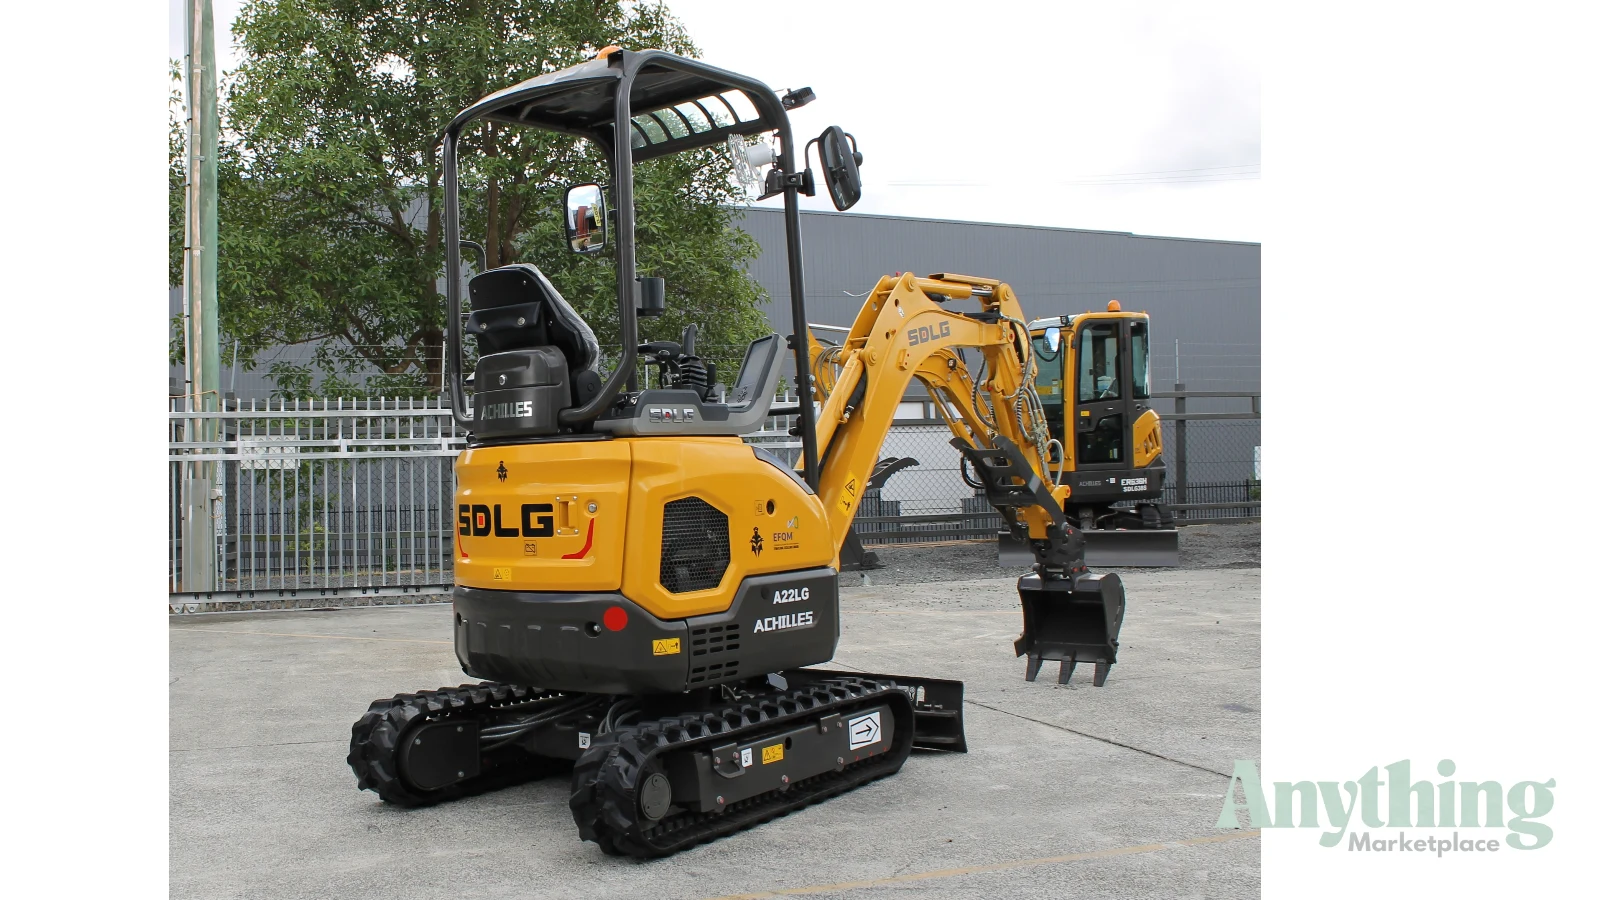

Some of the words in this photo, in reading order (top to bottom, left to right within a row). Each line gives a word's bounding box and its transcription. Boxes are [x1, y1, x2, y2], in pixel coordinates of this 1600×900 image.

[907, 321, 951, 347] SDLG
[481, 401, 533, 421] ACHILLES
[649, 408, 694, 423] SDLG
[458, 503, 554, 538] SDLG
[773, 532, 793, 543] EFQM
[773, 587, 810, 605] A22LG
[753, 611, 814, 634] ACHILLES
